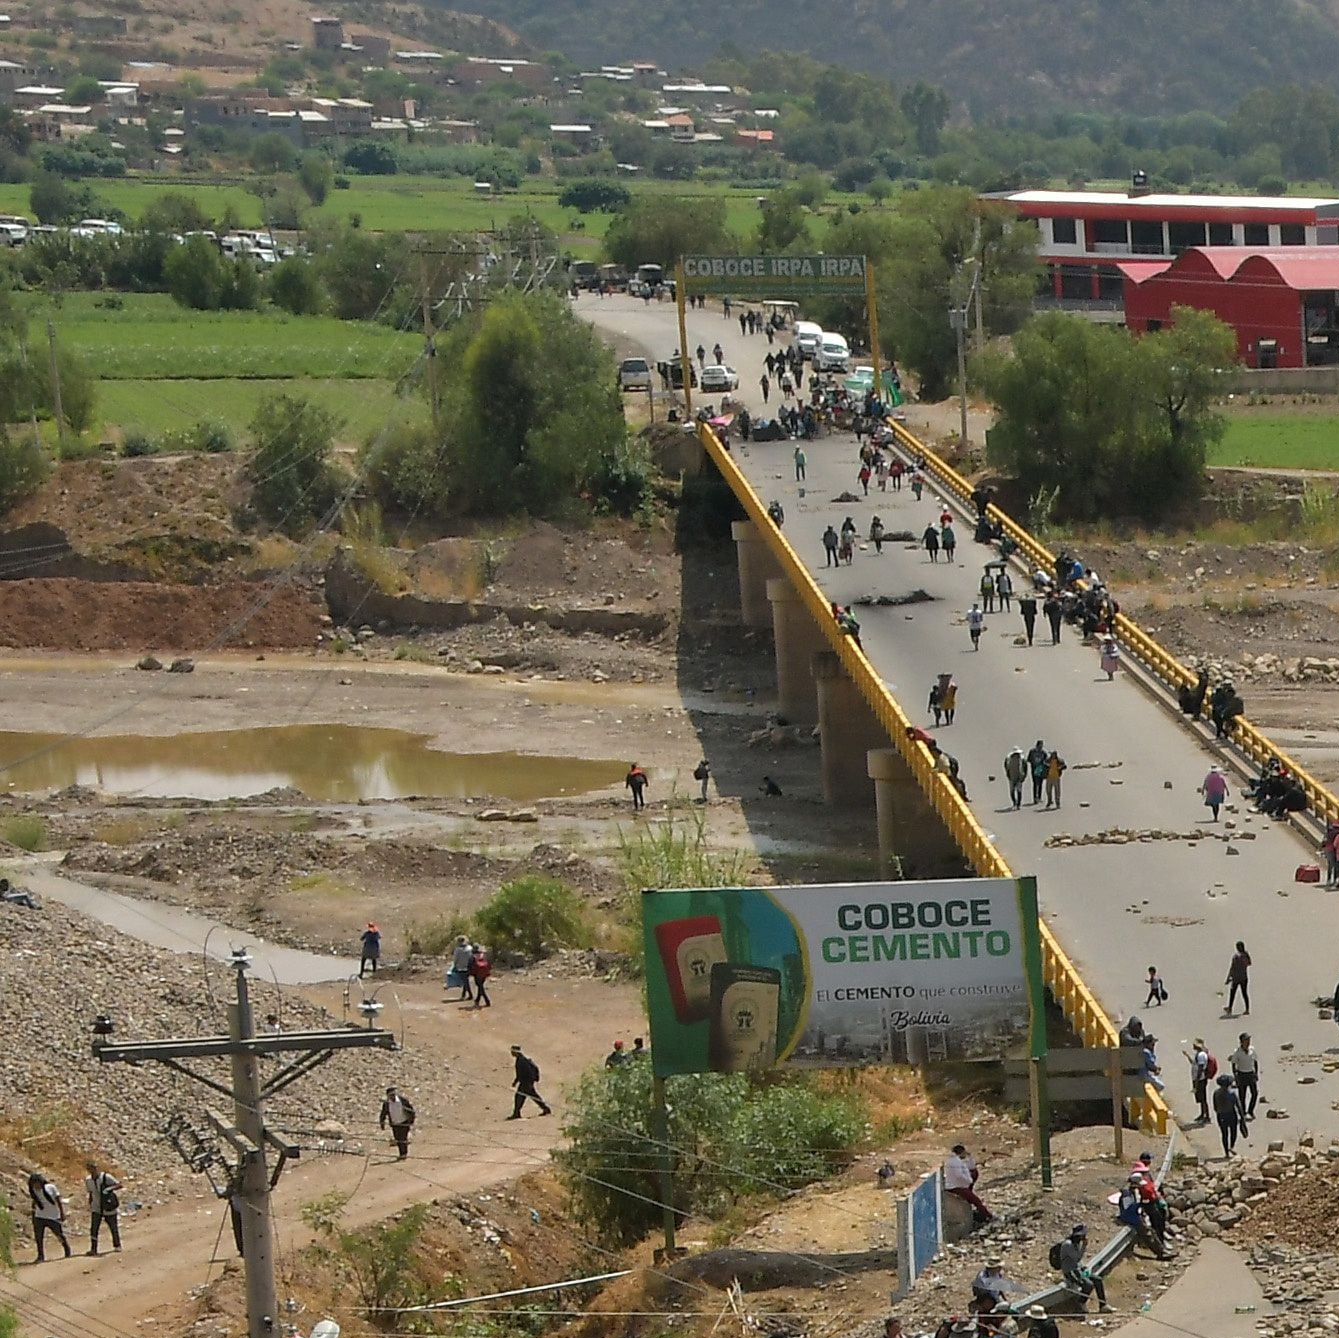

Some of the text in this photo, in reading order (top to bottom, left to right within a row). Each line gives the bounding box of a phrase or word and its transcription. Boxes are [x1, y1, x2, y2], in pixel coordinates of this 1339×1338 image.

[685, 259, 863, 276] COBOCE IRPA IRPA
[838, 899, 992, 931] COBOCE
[822, 929, 1011, 963] CEMENTO
[817, 990, 830, 1002] El
[834, 986, 915, 1001] CEMENTO
[949, 983, 1022, 999] construye
[891, 1010, 951, 1031] Bolivia
